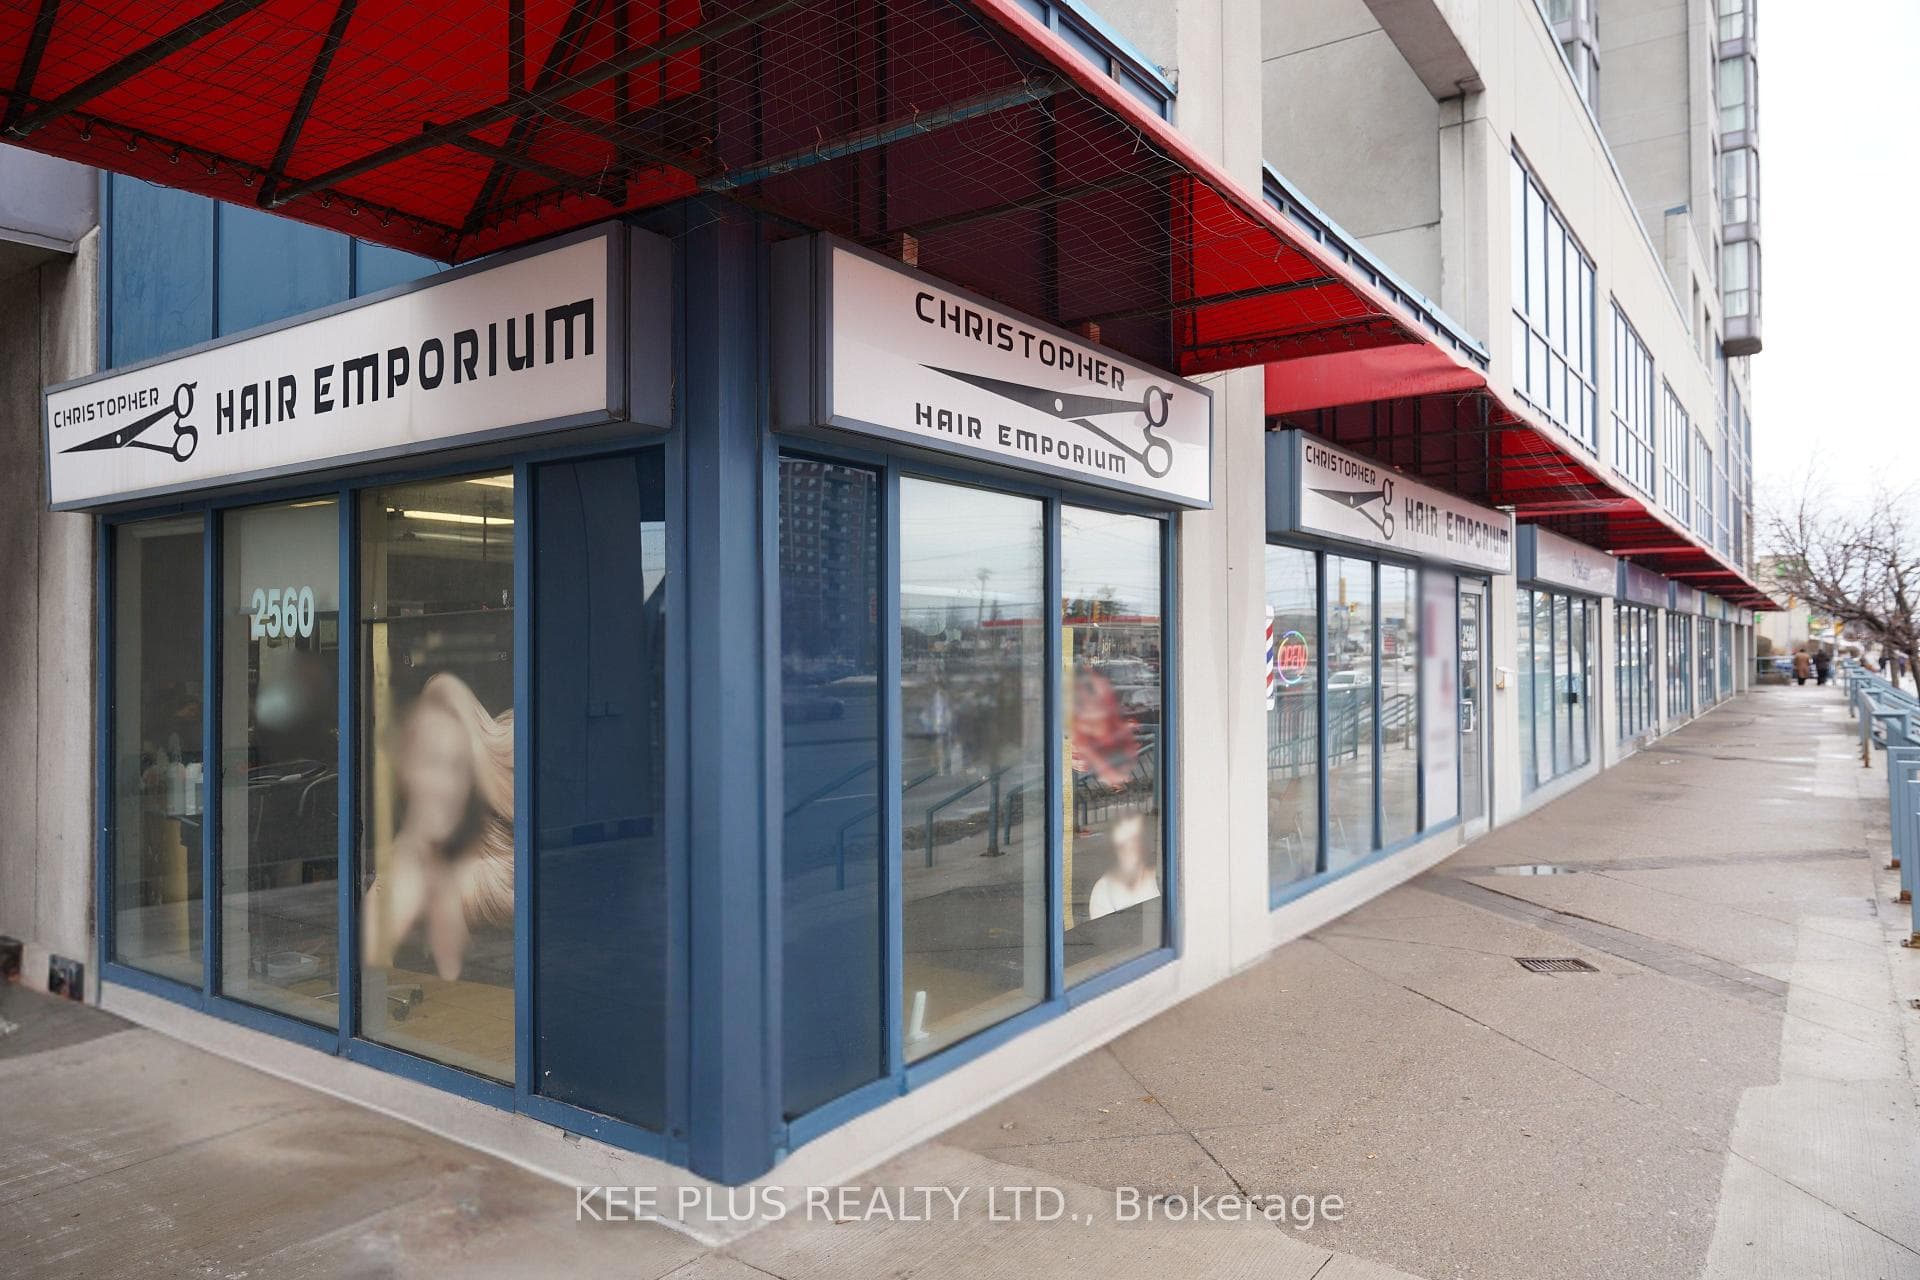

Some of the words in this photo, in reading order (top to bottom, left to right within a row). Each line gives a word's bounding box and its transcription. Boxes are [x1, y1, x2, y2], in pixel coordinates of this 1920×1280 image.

[216, 374, 297, 435] HAIR
[314, 298, 594, 415] EMPORIUM
[916, 291, 1125, 391] CHRISTOPHER
[54, 387, 159, 428] CHRISTOPHER
[915, 403, 982, 439] HAIR
[998, 424, 1126, 474] EMPORIUM
[1306, 445, 1376, 486] CHRISTOPHER
[1405, 497, 1438, 538] HAIR
[1446, 511, 1509, 557] EMPORIUM
[252, 585, 315, 638] 2560
[1279, 644, 1306, 671] OPEN
